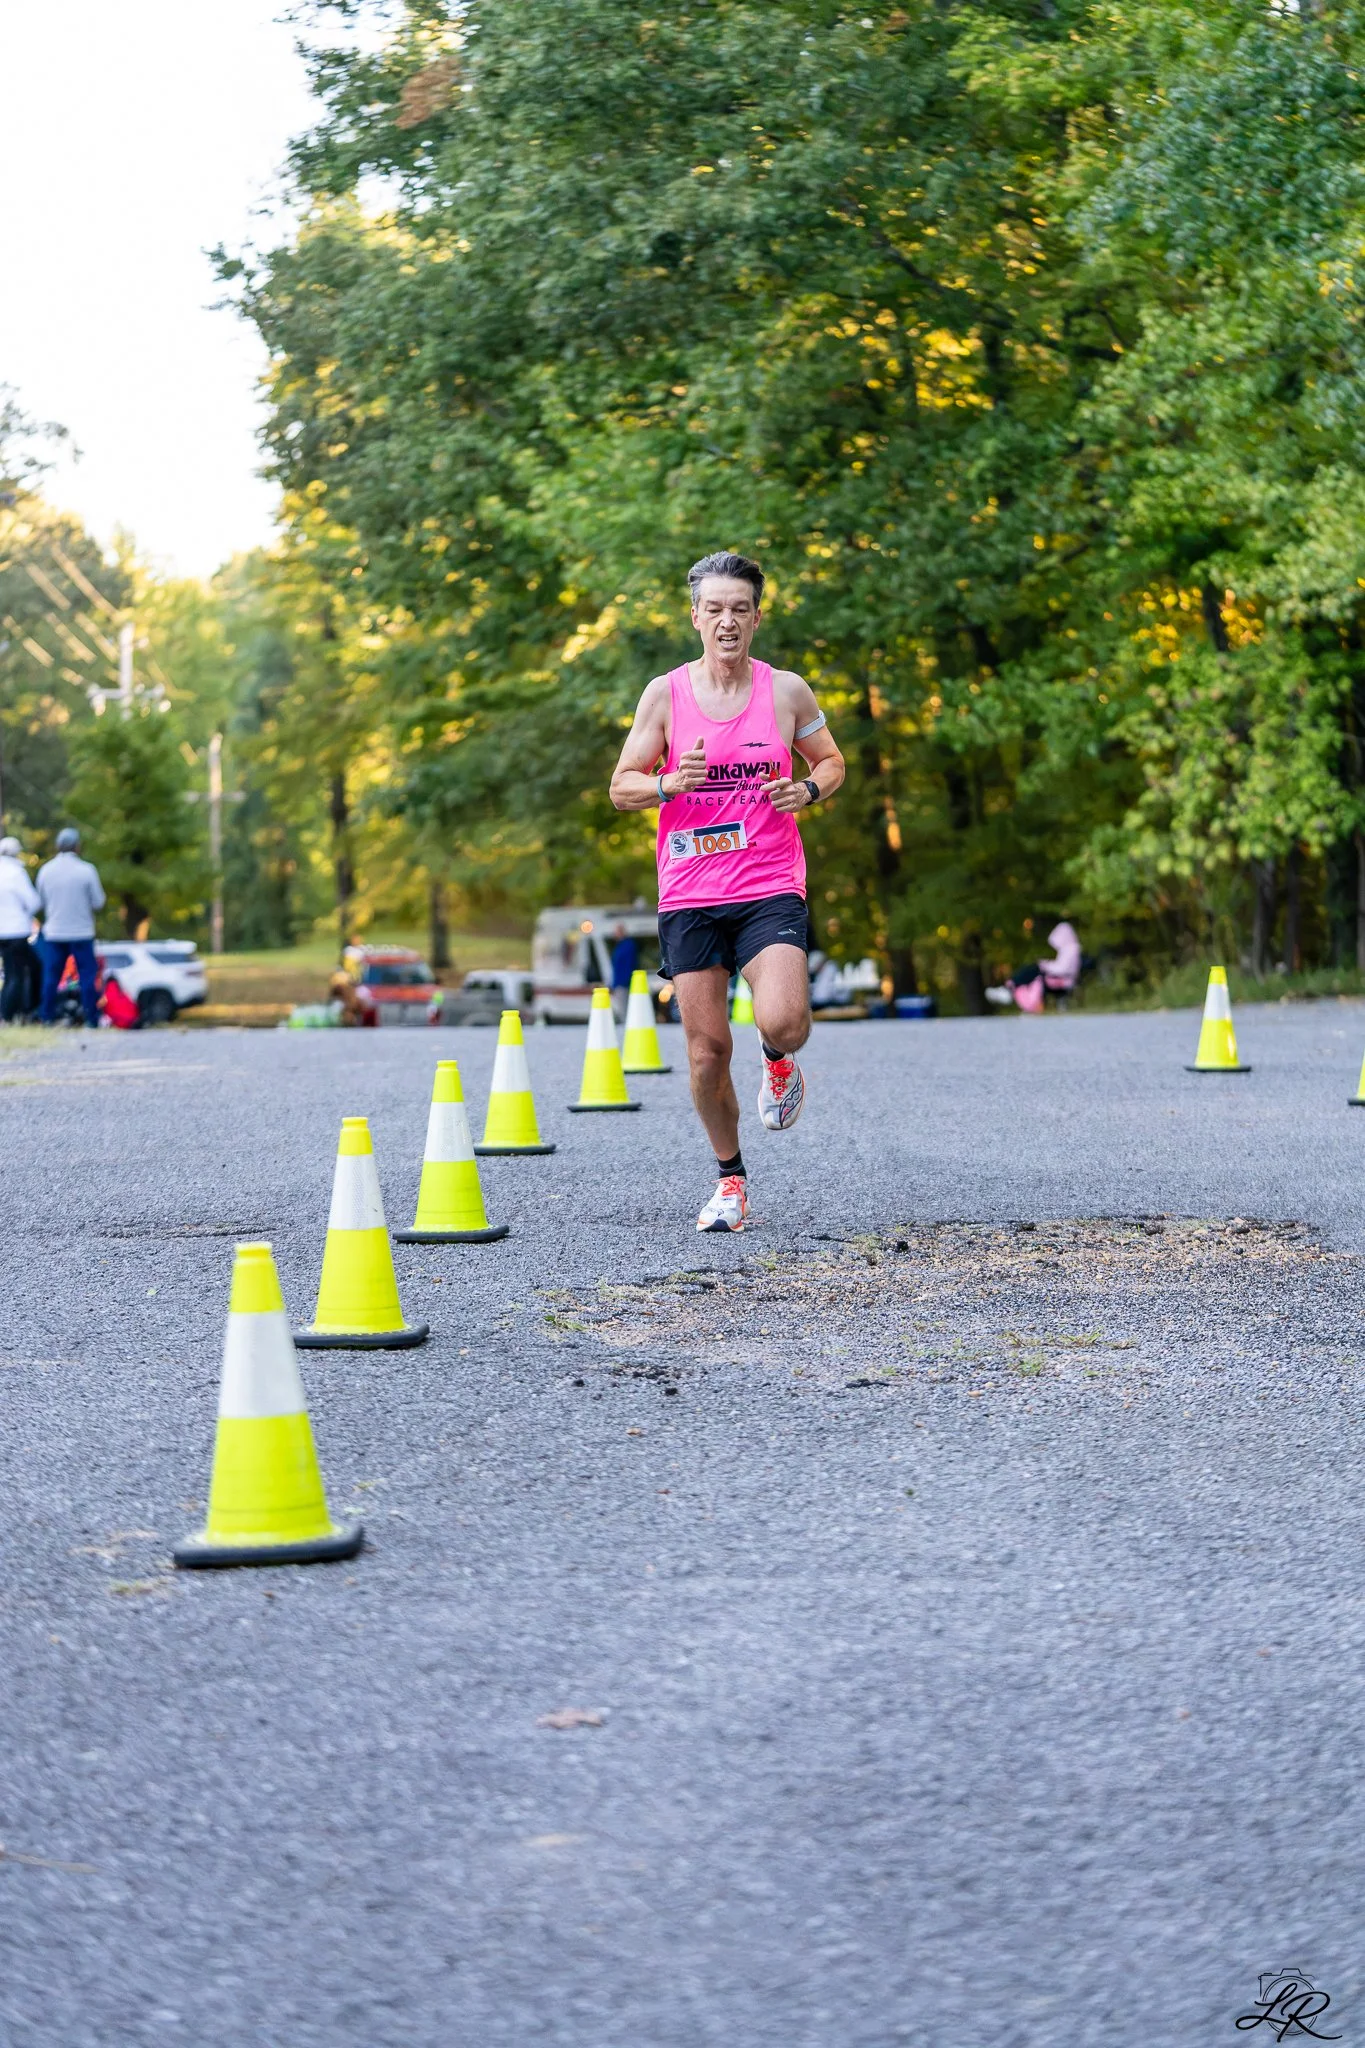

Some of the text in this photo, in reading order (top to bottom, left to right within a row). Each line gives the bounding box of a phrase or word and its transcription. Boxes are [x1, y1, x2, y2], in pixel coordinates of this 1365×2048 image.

[686, 794, 770, 807] RACE TEAM
[693, 831, 741, 855] 1061
